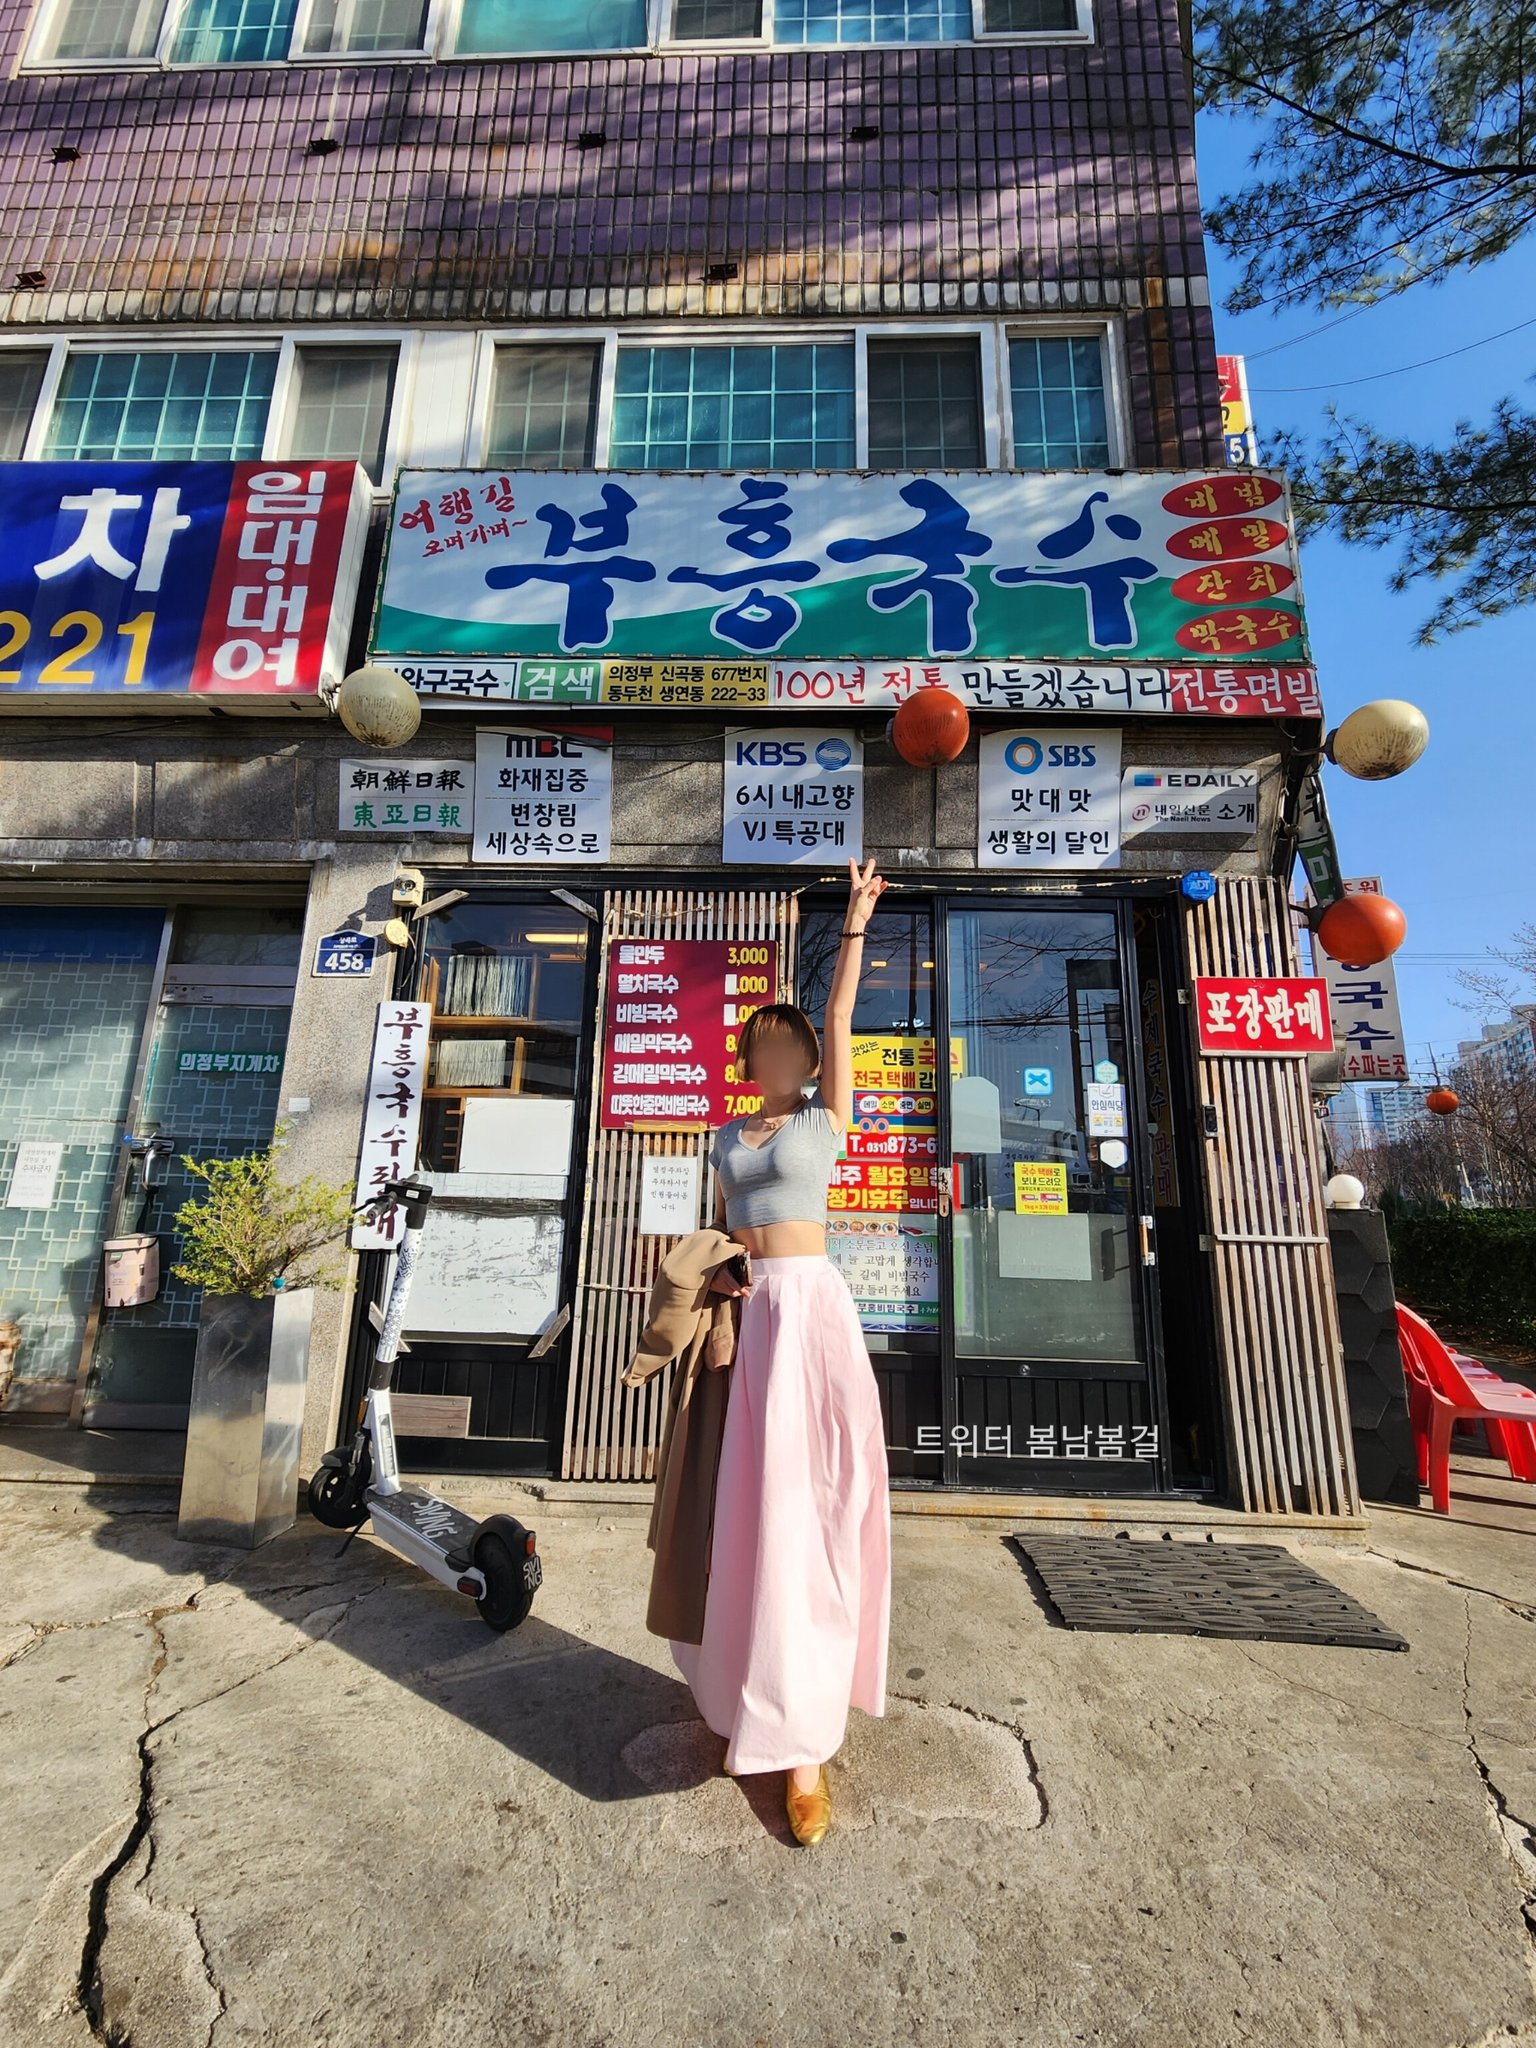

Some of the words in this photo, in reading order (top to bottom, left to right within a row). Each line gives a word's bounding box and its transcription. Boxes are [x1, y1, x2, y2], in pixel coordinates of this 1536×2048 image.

[1184, 477, 1265, 513] 비빔
[34, 487, 191, 592] 차
[1188, 520, 1270, 556] 메밀
[484, 477, 1158, 651] 부흥국수
[1196, 564, 1277, 600] 잔치
[1190, 612, 1293, 651] 막국수
[524, 667, 594, 699] 검색
[608, 665, 654, 682] 의정부
[660, 665, 705, 683] 신곡동
[711, 666, 767, 683] 677번지
[607, 685, 653, 702] 동두천
[659, 685, 705, 703] 생연동
[711, 687, 766, 702] 222-33
[775, 665, 866, 704] 100년
[961, 667, 1171, 711] 만들겠습니다
[506, 735, 583, 758] MBC
[736, 741, 807, 766] KBS
[1048, 744, 1096, 767] SBS
[350, 769, 465, 794] 朝鮮日報
[498, 767, 589, 792] 화재집중
[1168, 774, 1254, 787] EDAILY
[736, 784, 774, 809] 6시
[782, 784, 855, 810] 내고향
[353, 801, 462, 829] 東亞日報
[510, 803, 577, 828] 변창림
[1155, 804, 1212, 816] 내일신문
[1217, 802, 1255, 823] 소개
[486, 832, 600, 856] 세상속으로
[743, 821, 767, 841] VJ
[772, 820, 845, 846] 특공대
[987, 830, 1056, 855] 생활의
[1065, 830, 1109, 855] 달인
[1190, 880, 1210, 890] ADT
[325, 952, 364, 971] 458
[618, 945, 665, 965] 물만두
[728, 947, 768, 966] 3,000
[618, 973, 680, 994] 멸치국수
[616, 1003, 679, 1024] 비빔국수
[1206, 987, 1324, 1040] 포장판매
[614, 1033, 693, 1054] 메밀막국수
[179, 1053, 280, 1073] 의정부지게차
[882, 1048, 915, 1067] 전통
[854, 1070, 883, 1088] 전국
[886, 1070, 916, 1089] 택배
[827, 1188, 909, 1209] 정기휴무
[888, 1270, 930, 1282] 비빔국수
[890, 1285, 922, 1297] 주세요
